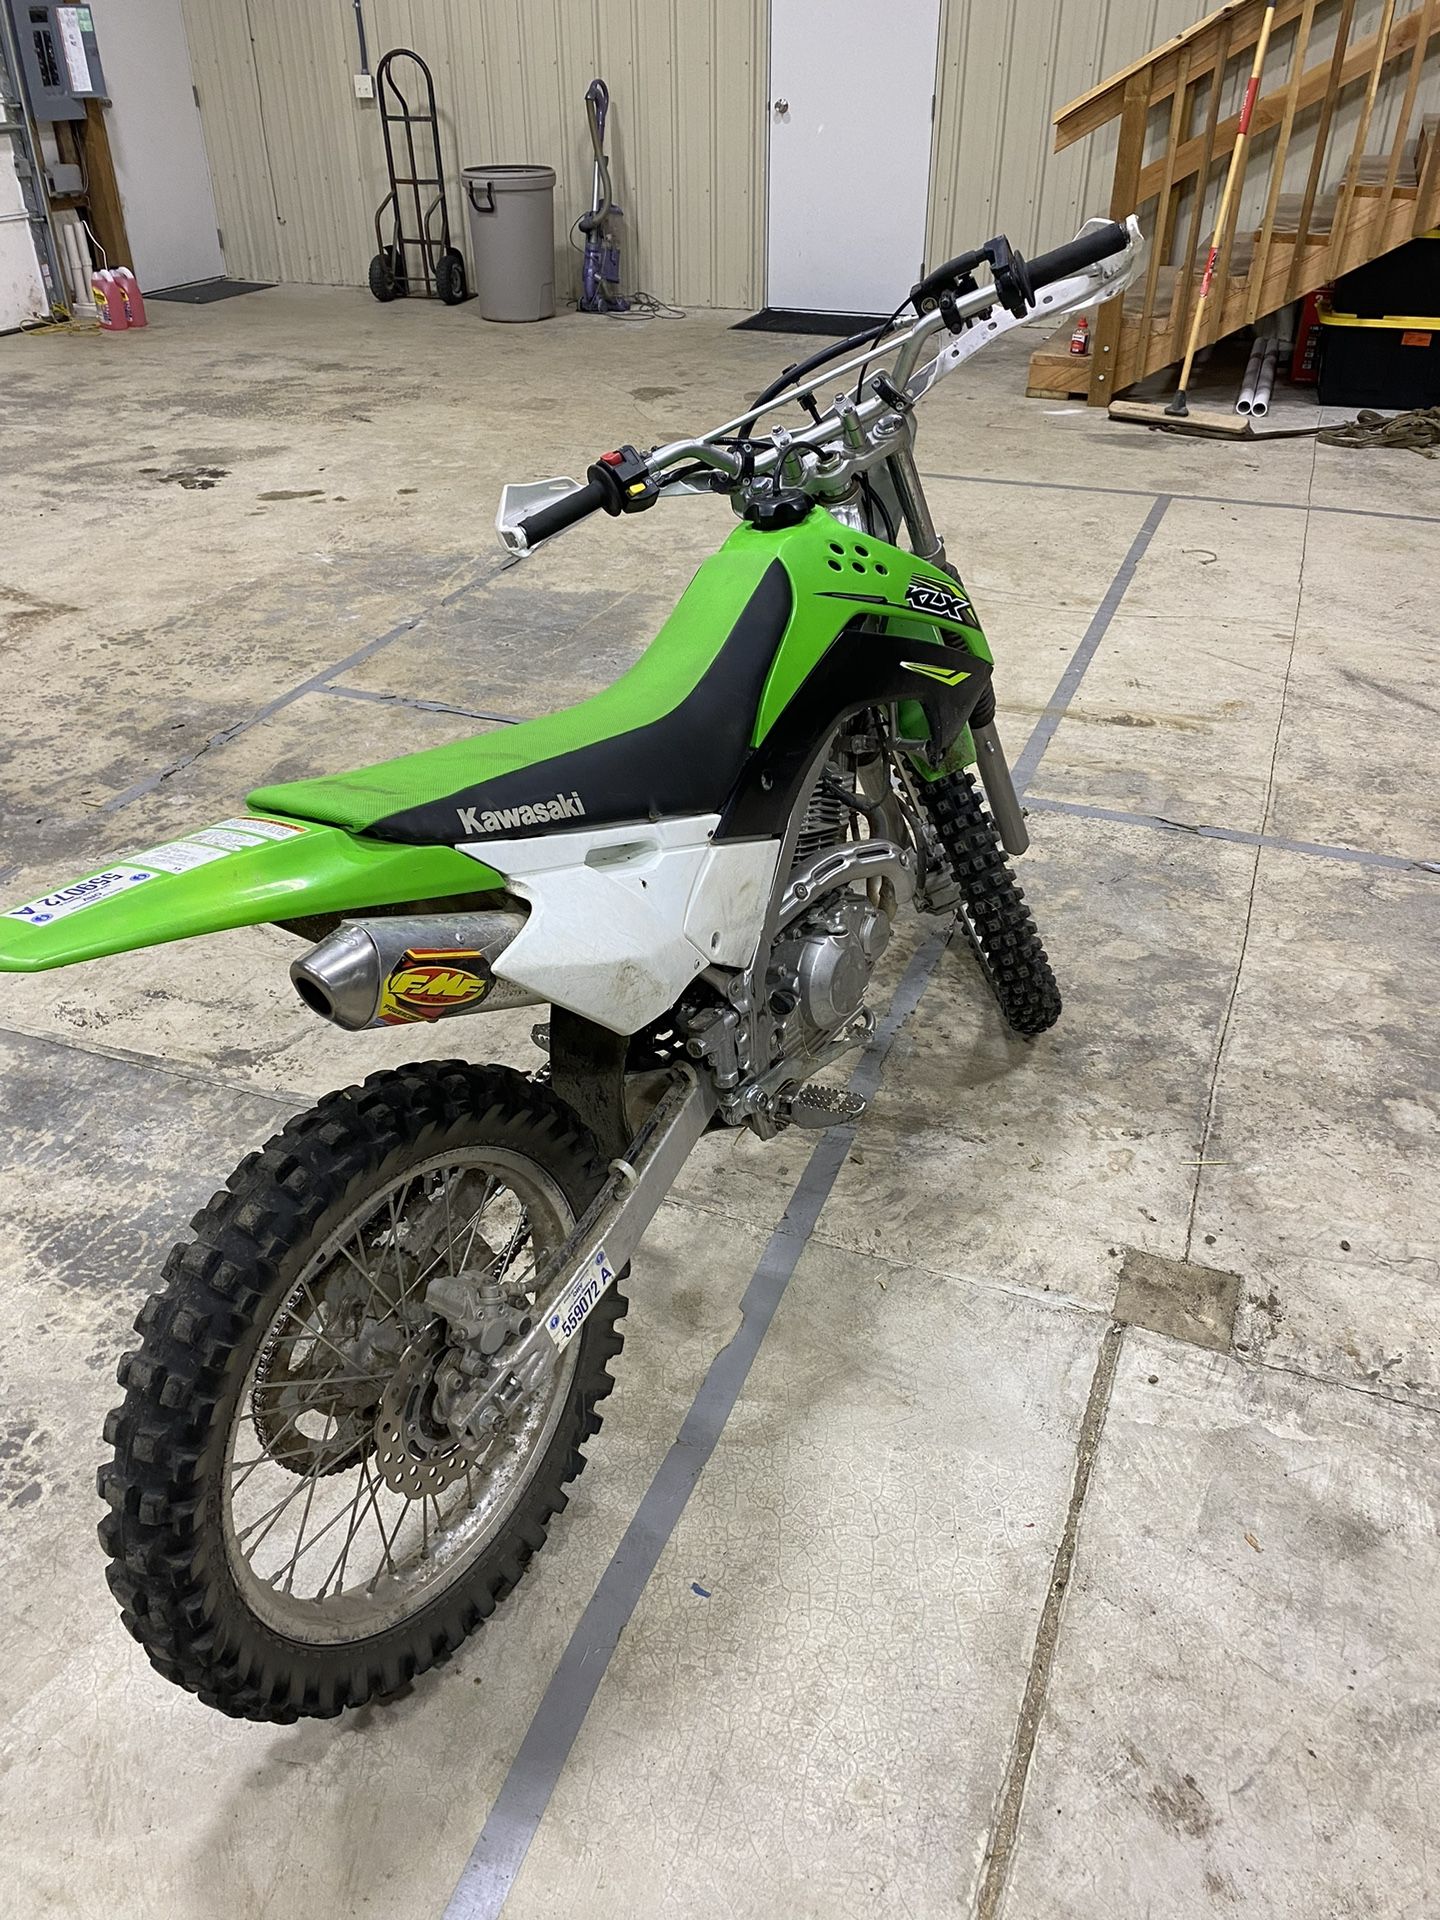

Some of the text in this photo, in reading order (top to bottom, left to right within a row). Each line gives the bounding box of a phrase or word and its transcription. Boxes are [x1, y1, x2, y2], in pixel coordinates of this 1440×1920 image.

[456, 791, 586, 835] Kawasaki
[36, 872, 124, 907] 559072
[9, 906, 36, 916] A
[389, 972, 487, 998] FMF
[562, 1280, 601, 1338] 559072
[600, 1267, 613, 1285] A
